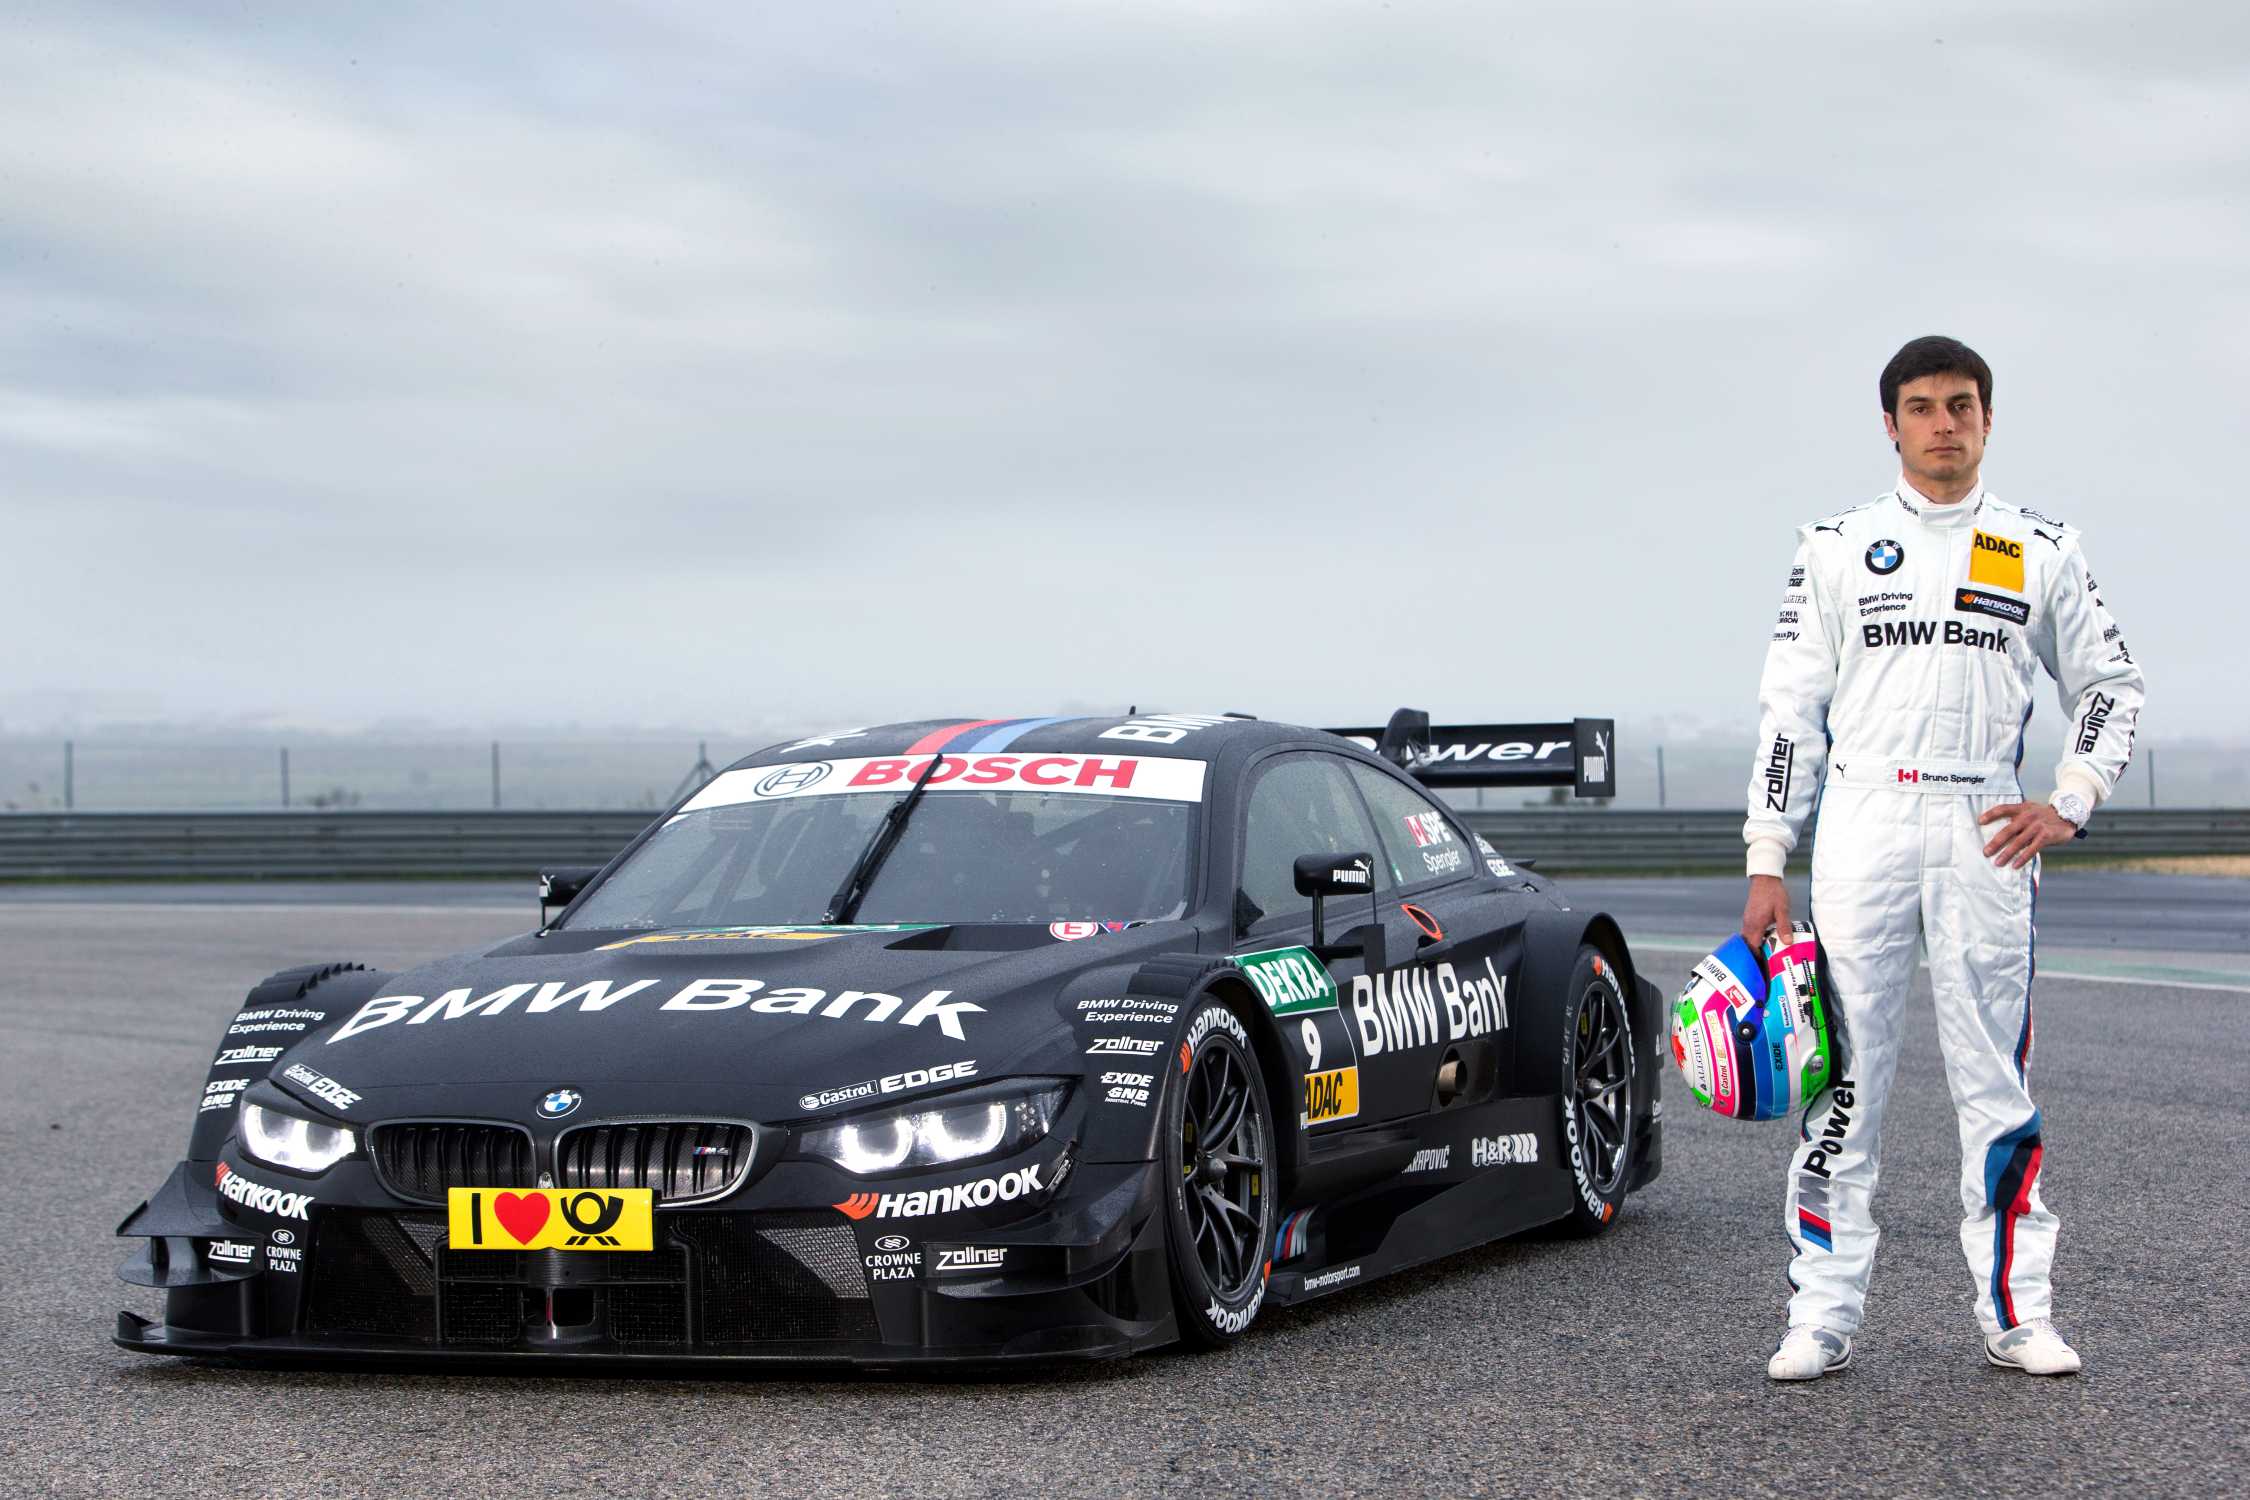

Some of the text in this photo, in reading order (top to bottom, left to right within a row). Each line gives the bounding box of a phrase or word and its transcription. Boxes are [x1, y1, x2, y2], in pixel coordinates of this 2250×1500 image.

[1974, 533, 2020, 558] ADAC
[1858, 592, 1913, 606] BMW Driving
[1860, 603, 1906, 617] Experience
[1862, 621, 2009, 654] BMW Bank
[2075, 691, 2115, 754] zollne
[846, 756, 1138, 789] BOSCH
[1922, 773, 1986, 784] Bruno Spengler
[1423, 848, 1461, 875] Spengler
[1244, 955, 1331, 1006] DEKRA
[236, 1009, 326, 1022] BMW Driving
[326, 978, 988, 1045] BMW Bank
[1077, 999, 1178, 1013] BMW Driving
[1085, 1011, 1173, 1024] Experience
[1353, 966, 1438, 1057] BMW
[1437, 956, 1509, 1040] Bank
[228, 1021, 306, 1034] Experience
[1301, 1018, 1321, 1070] 9
[206, 1078, 250, 1094] EXIDE
[820, 1060, 979, 1105] Castrol EDGE
[1100, 1071, 1154, 1087] EXIDE
[307, 1077, 363, 1110] EDGE
[1107, 1086, 1149, 1101] GNB
[1304, 1071, 1343, 1118] ADAC
[1802, 1080, 1855, 1178] Power
[1472, 1136, 1513, 1166] H&R
[471, 1193, 482, 1244] I
[266, 1246, 302, 1260] CROWNE
[865, 1253, 922, 1267] CROWNE
[270, 1260, 297, 1272] PLAZA
[873, 1267, 915, 1280] PLAZA
[1304, 1266, 1360, 1291] bmw-motorsport.com
